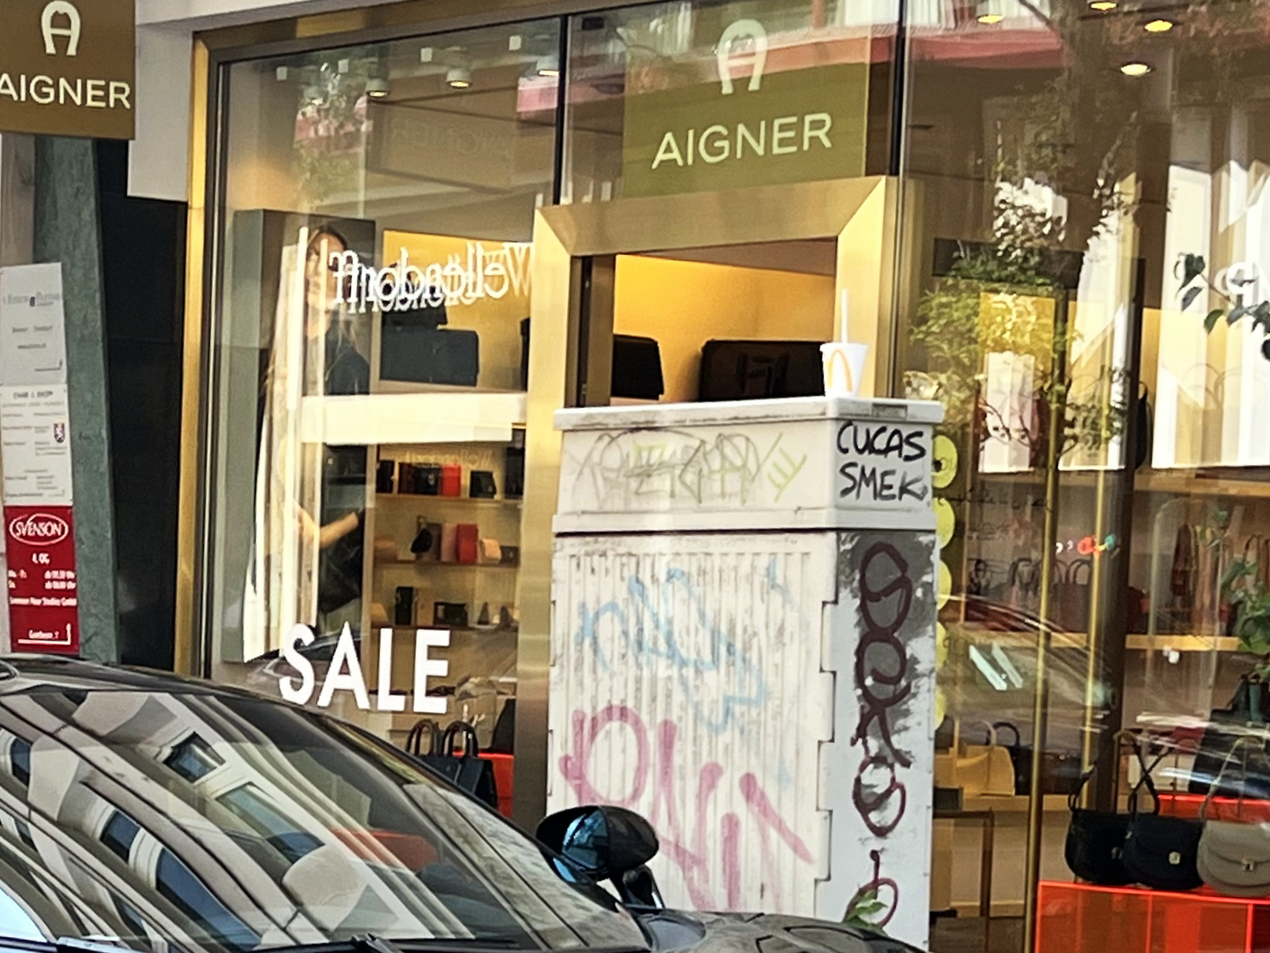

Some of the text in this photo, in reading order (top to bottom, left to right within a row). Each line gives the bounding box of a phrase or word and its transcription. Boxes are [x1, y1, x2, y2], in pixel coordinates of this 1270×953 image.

[652, 113, 832, 169] AIGNER
[15, 521, 62, 537] SVENSON
[279, 621, 451, 714] SALE
